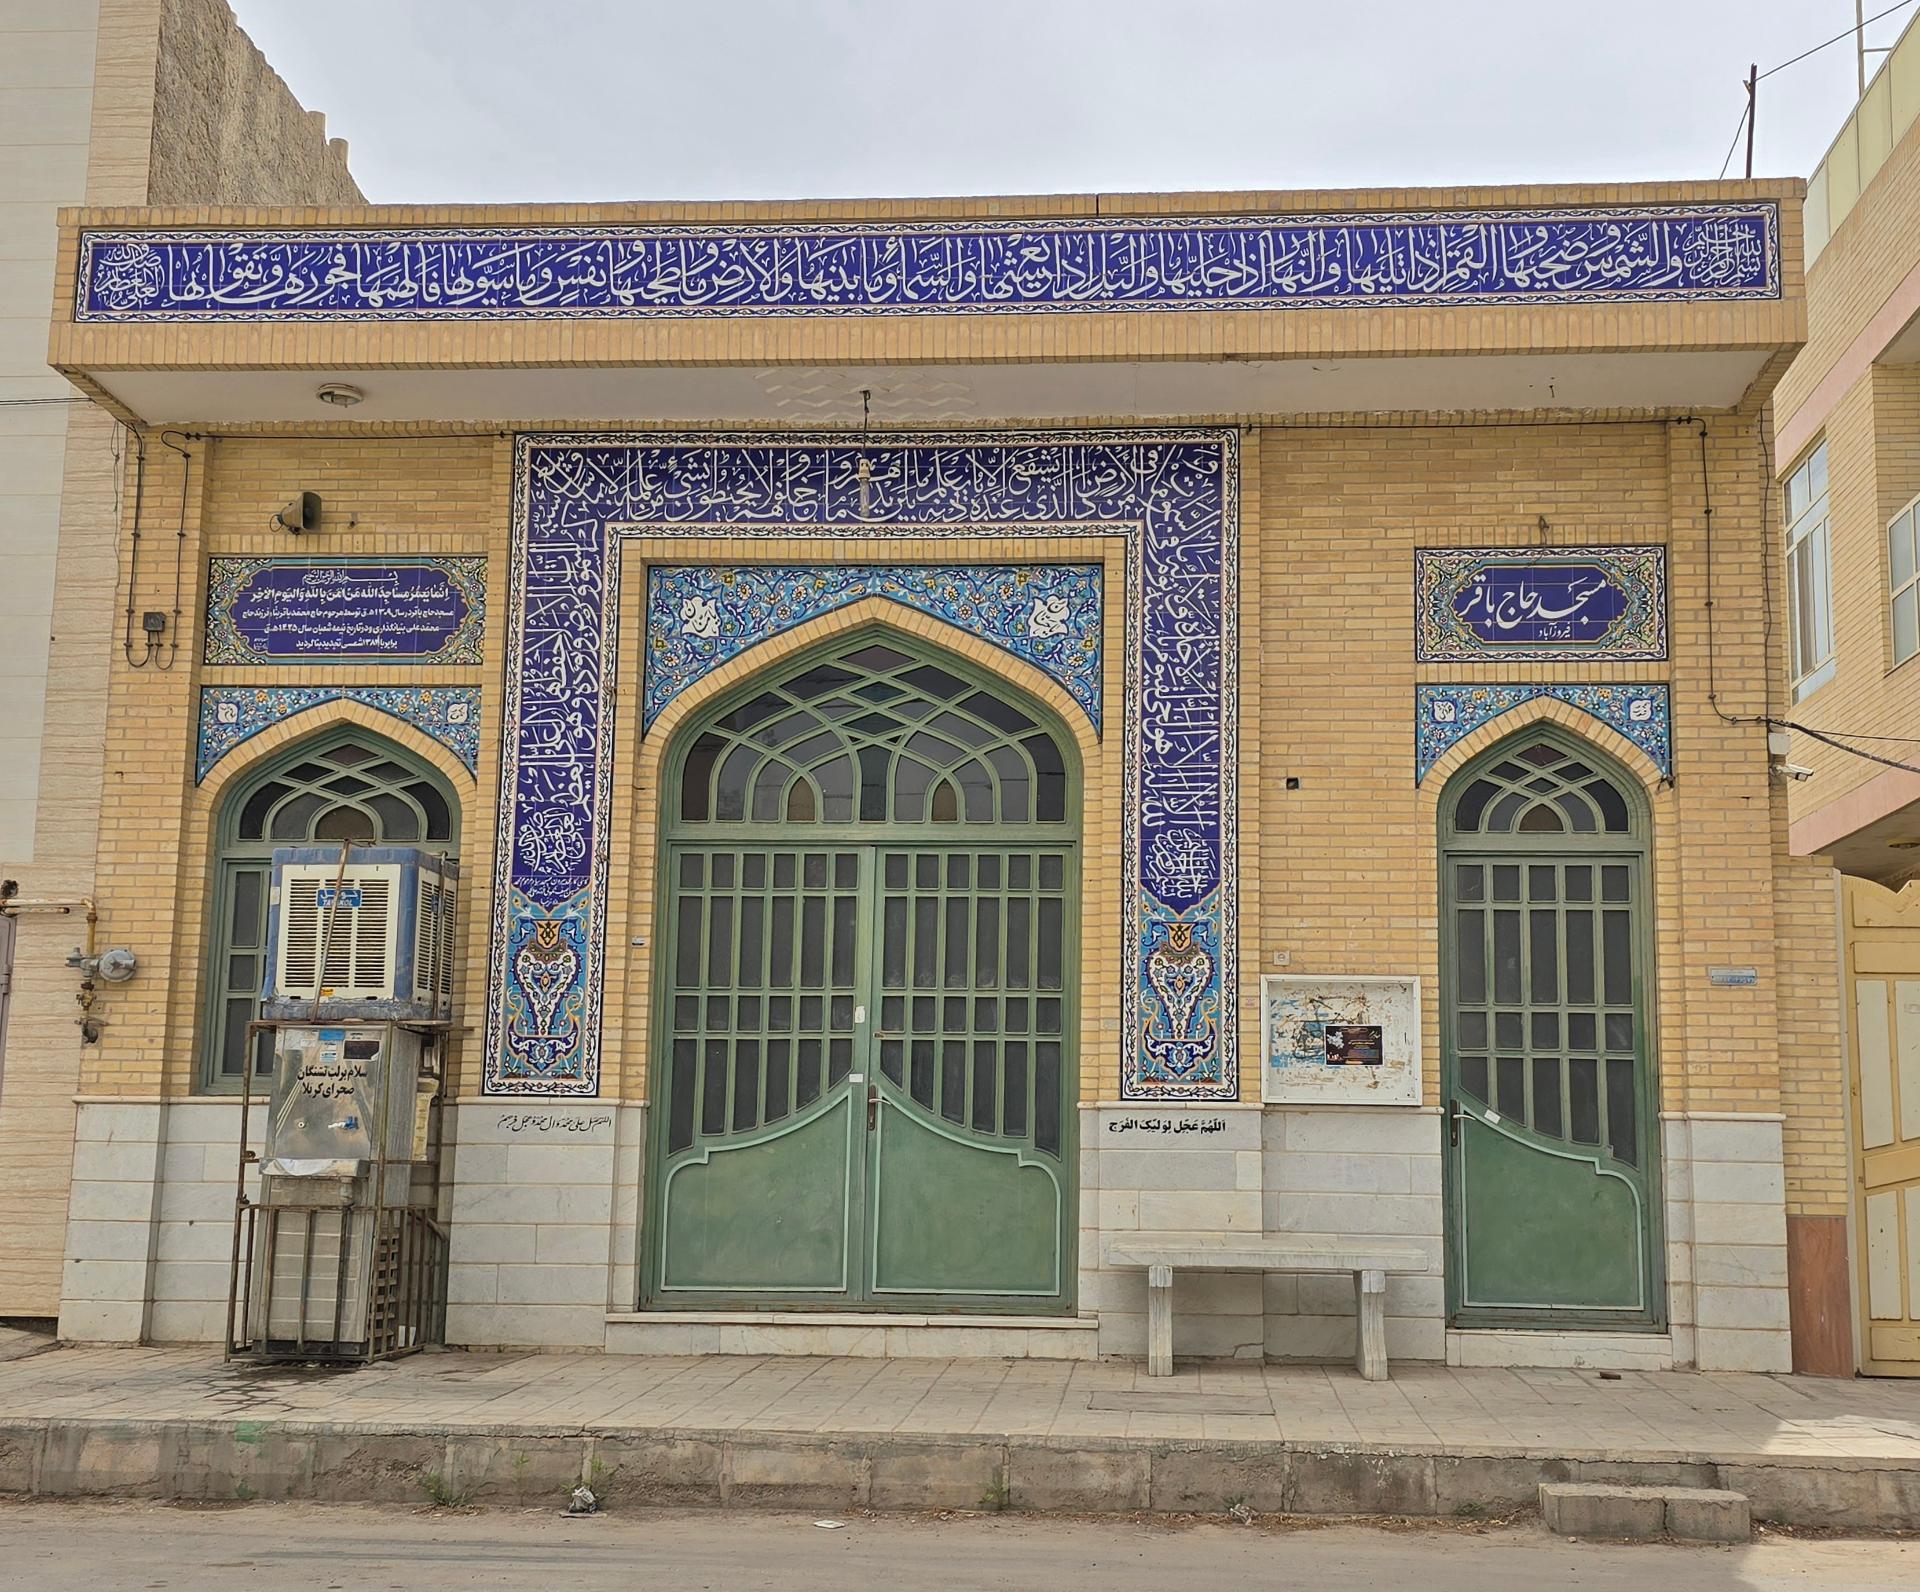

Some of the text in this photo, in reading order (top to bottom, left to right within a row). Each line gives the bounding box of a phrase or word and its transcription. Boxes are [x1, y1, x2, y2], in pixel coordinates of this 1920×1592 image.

[1459, 574, 1607, 629] مسجد حاج باقر
[322, 1083, 355, 1098] صحرای
